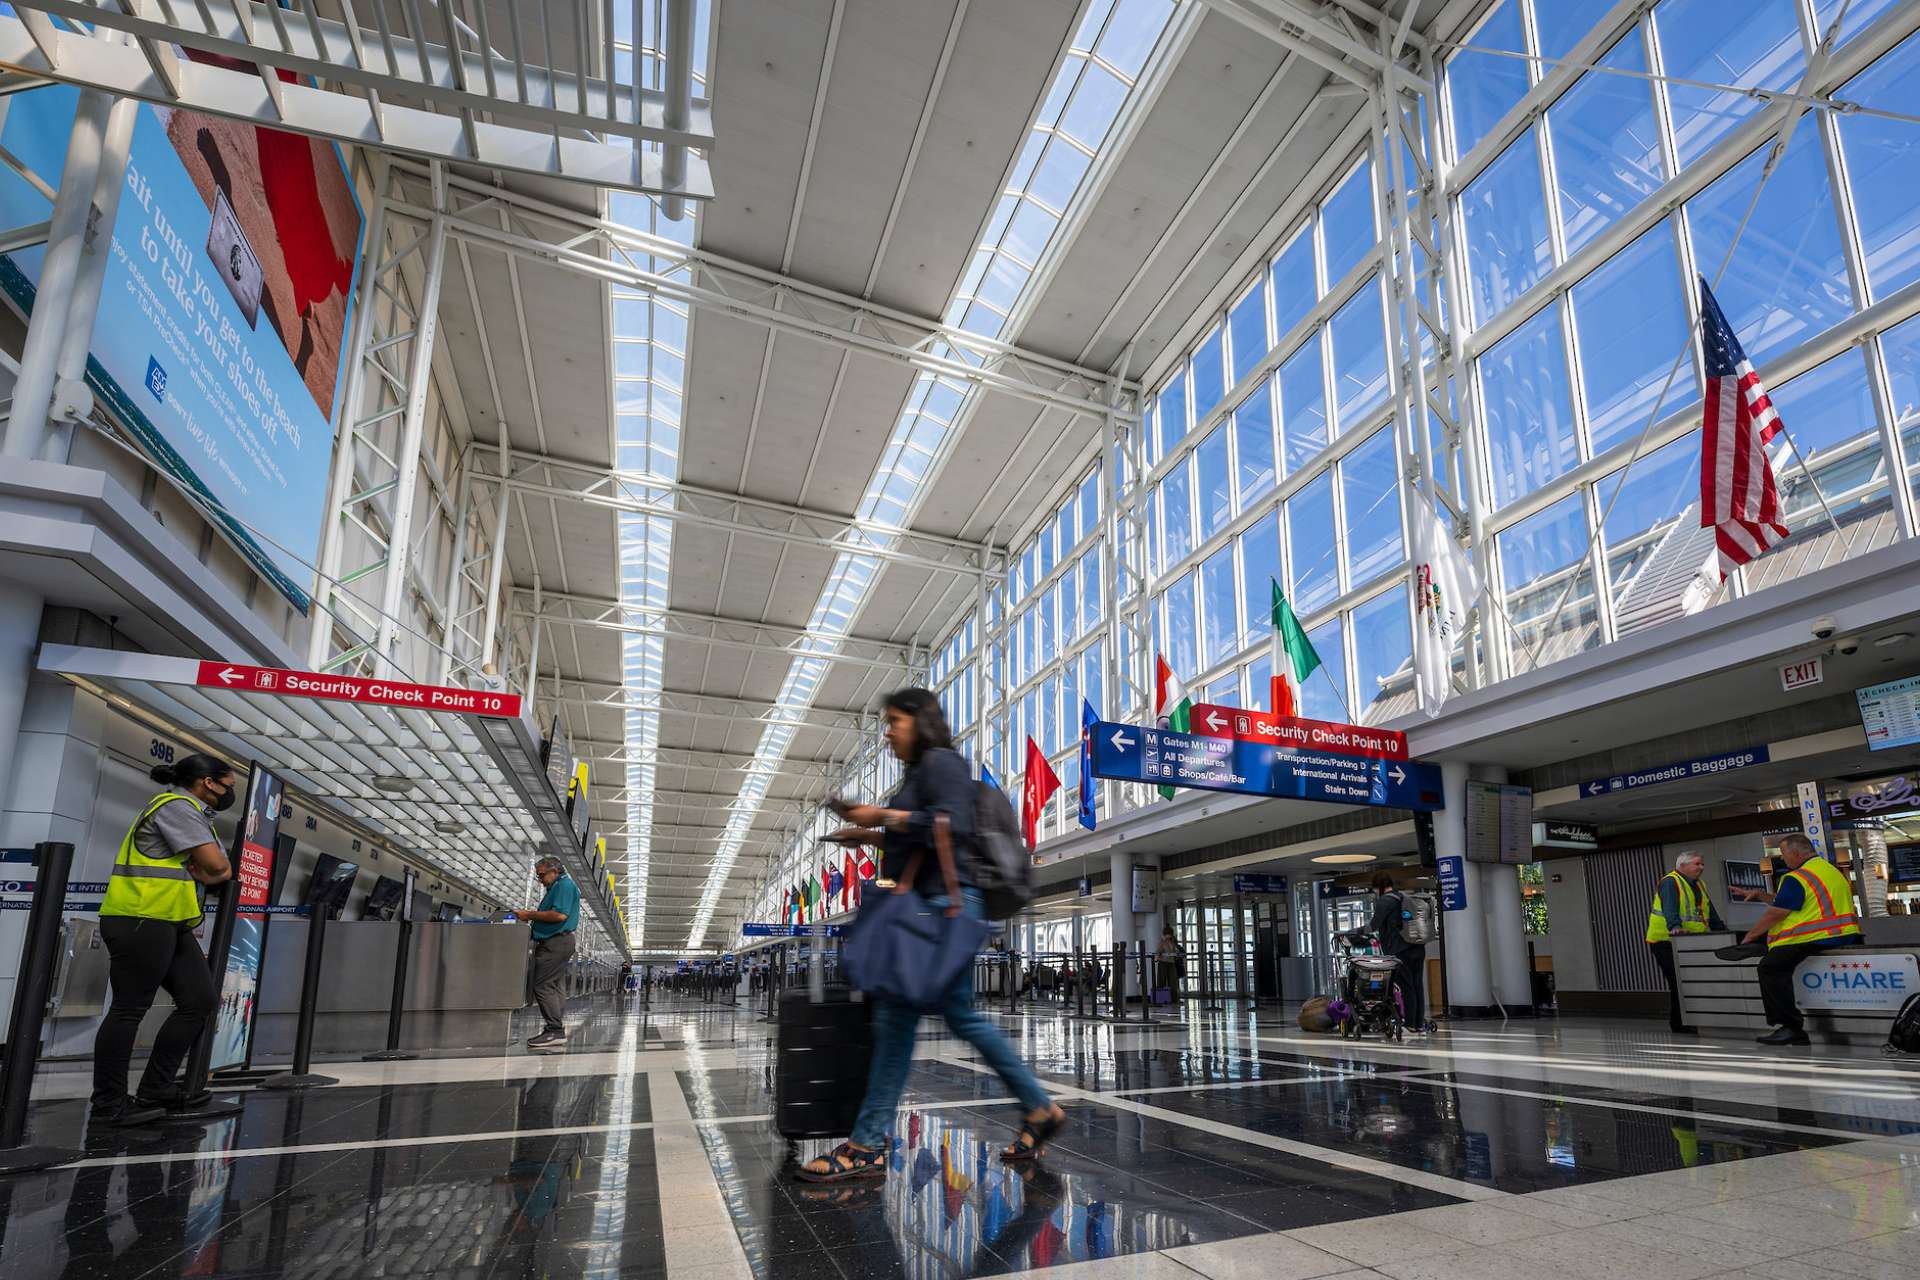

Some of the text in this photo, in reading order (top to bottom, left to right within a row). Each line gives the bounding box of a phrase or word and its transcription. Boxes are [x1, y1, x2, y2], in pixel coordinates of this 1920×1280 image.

[111, 235, 128, 263] njoy
[127, 153, 301, 451] ait until you get to the beach
[142, 225, 278, 445] to take your shoes off.
[1784, 661, 1817, 684] EXIT
[285, 675, 501, 711] Security Check Point 10
[1163, 737, 1189, 748] Gates
[1257, 721, 1398, 752] Security Check Point 10
[150, 738, 174, 764] 39B
[1164, 752, 1225, 768] All Departures
[1276, 751, 1358, 769] Transportation/Parking
[1178, 768, 1246, 785] Shops/Café/Bar
[1293, 768, 1368, 783] International Arrivals
[1628, 753, 1753, 787] Domestic Baggage
[1325, 784, 1369, 796] Stairs Down
[281, 804, 293, 819] 8B
[79, 884, 107, 892] INTER
[1803, 971, 1906, 989] O'HARE
